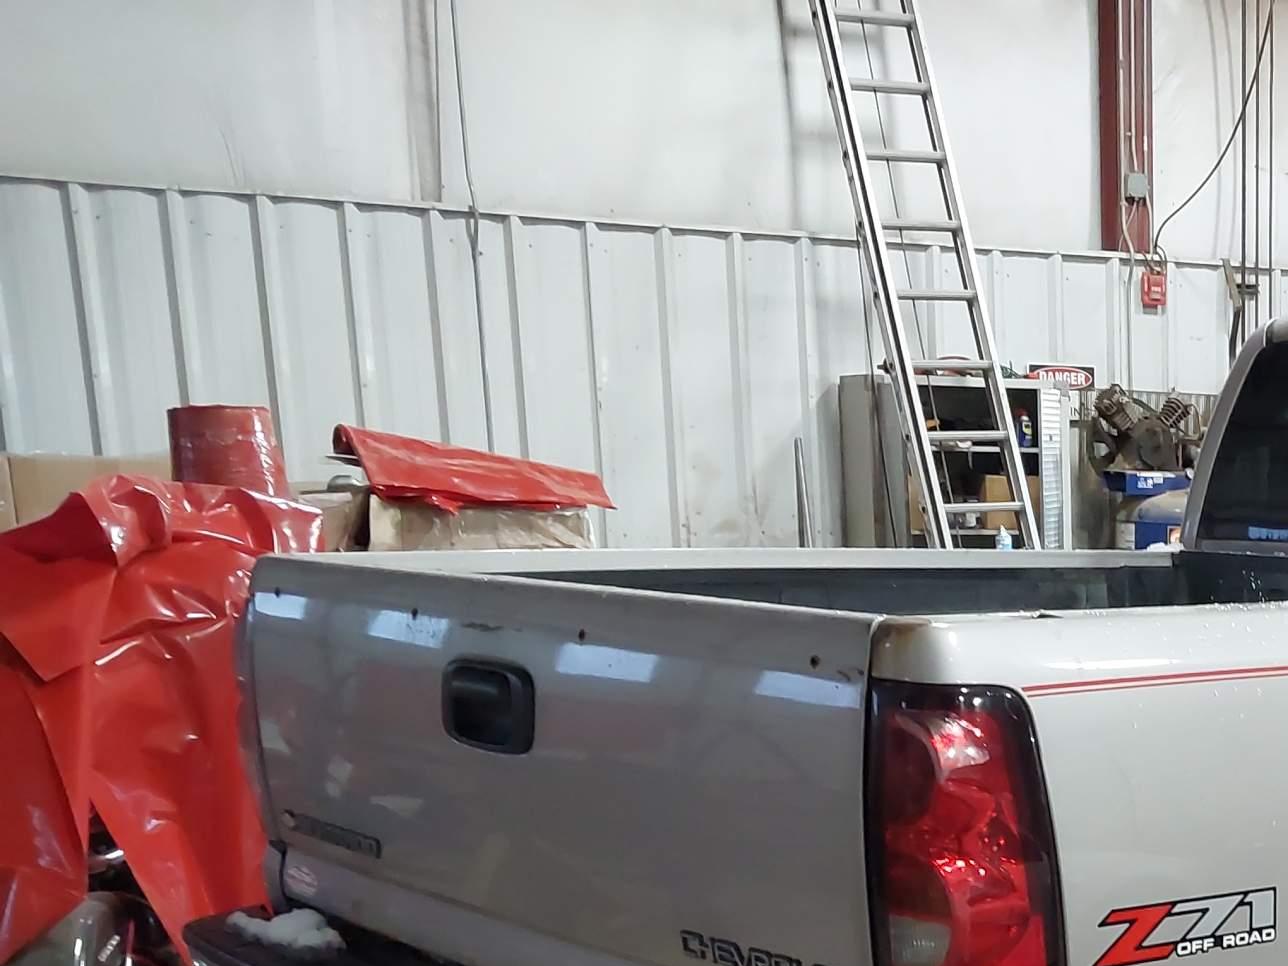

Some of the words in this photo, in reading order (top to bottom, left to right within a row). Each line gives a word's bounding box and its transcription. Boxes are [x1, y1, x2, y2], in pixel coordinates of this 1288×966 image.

[1039, 371, 1086, 385] DANGER
[1176, 937, 1215, 956] OFF
[1223, 929, 1276, 948] ROAD
